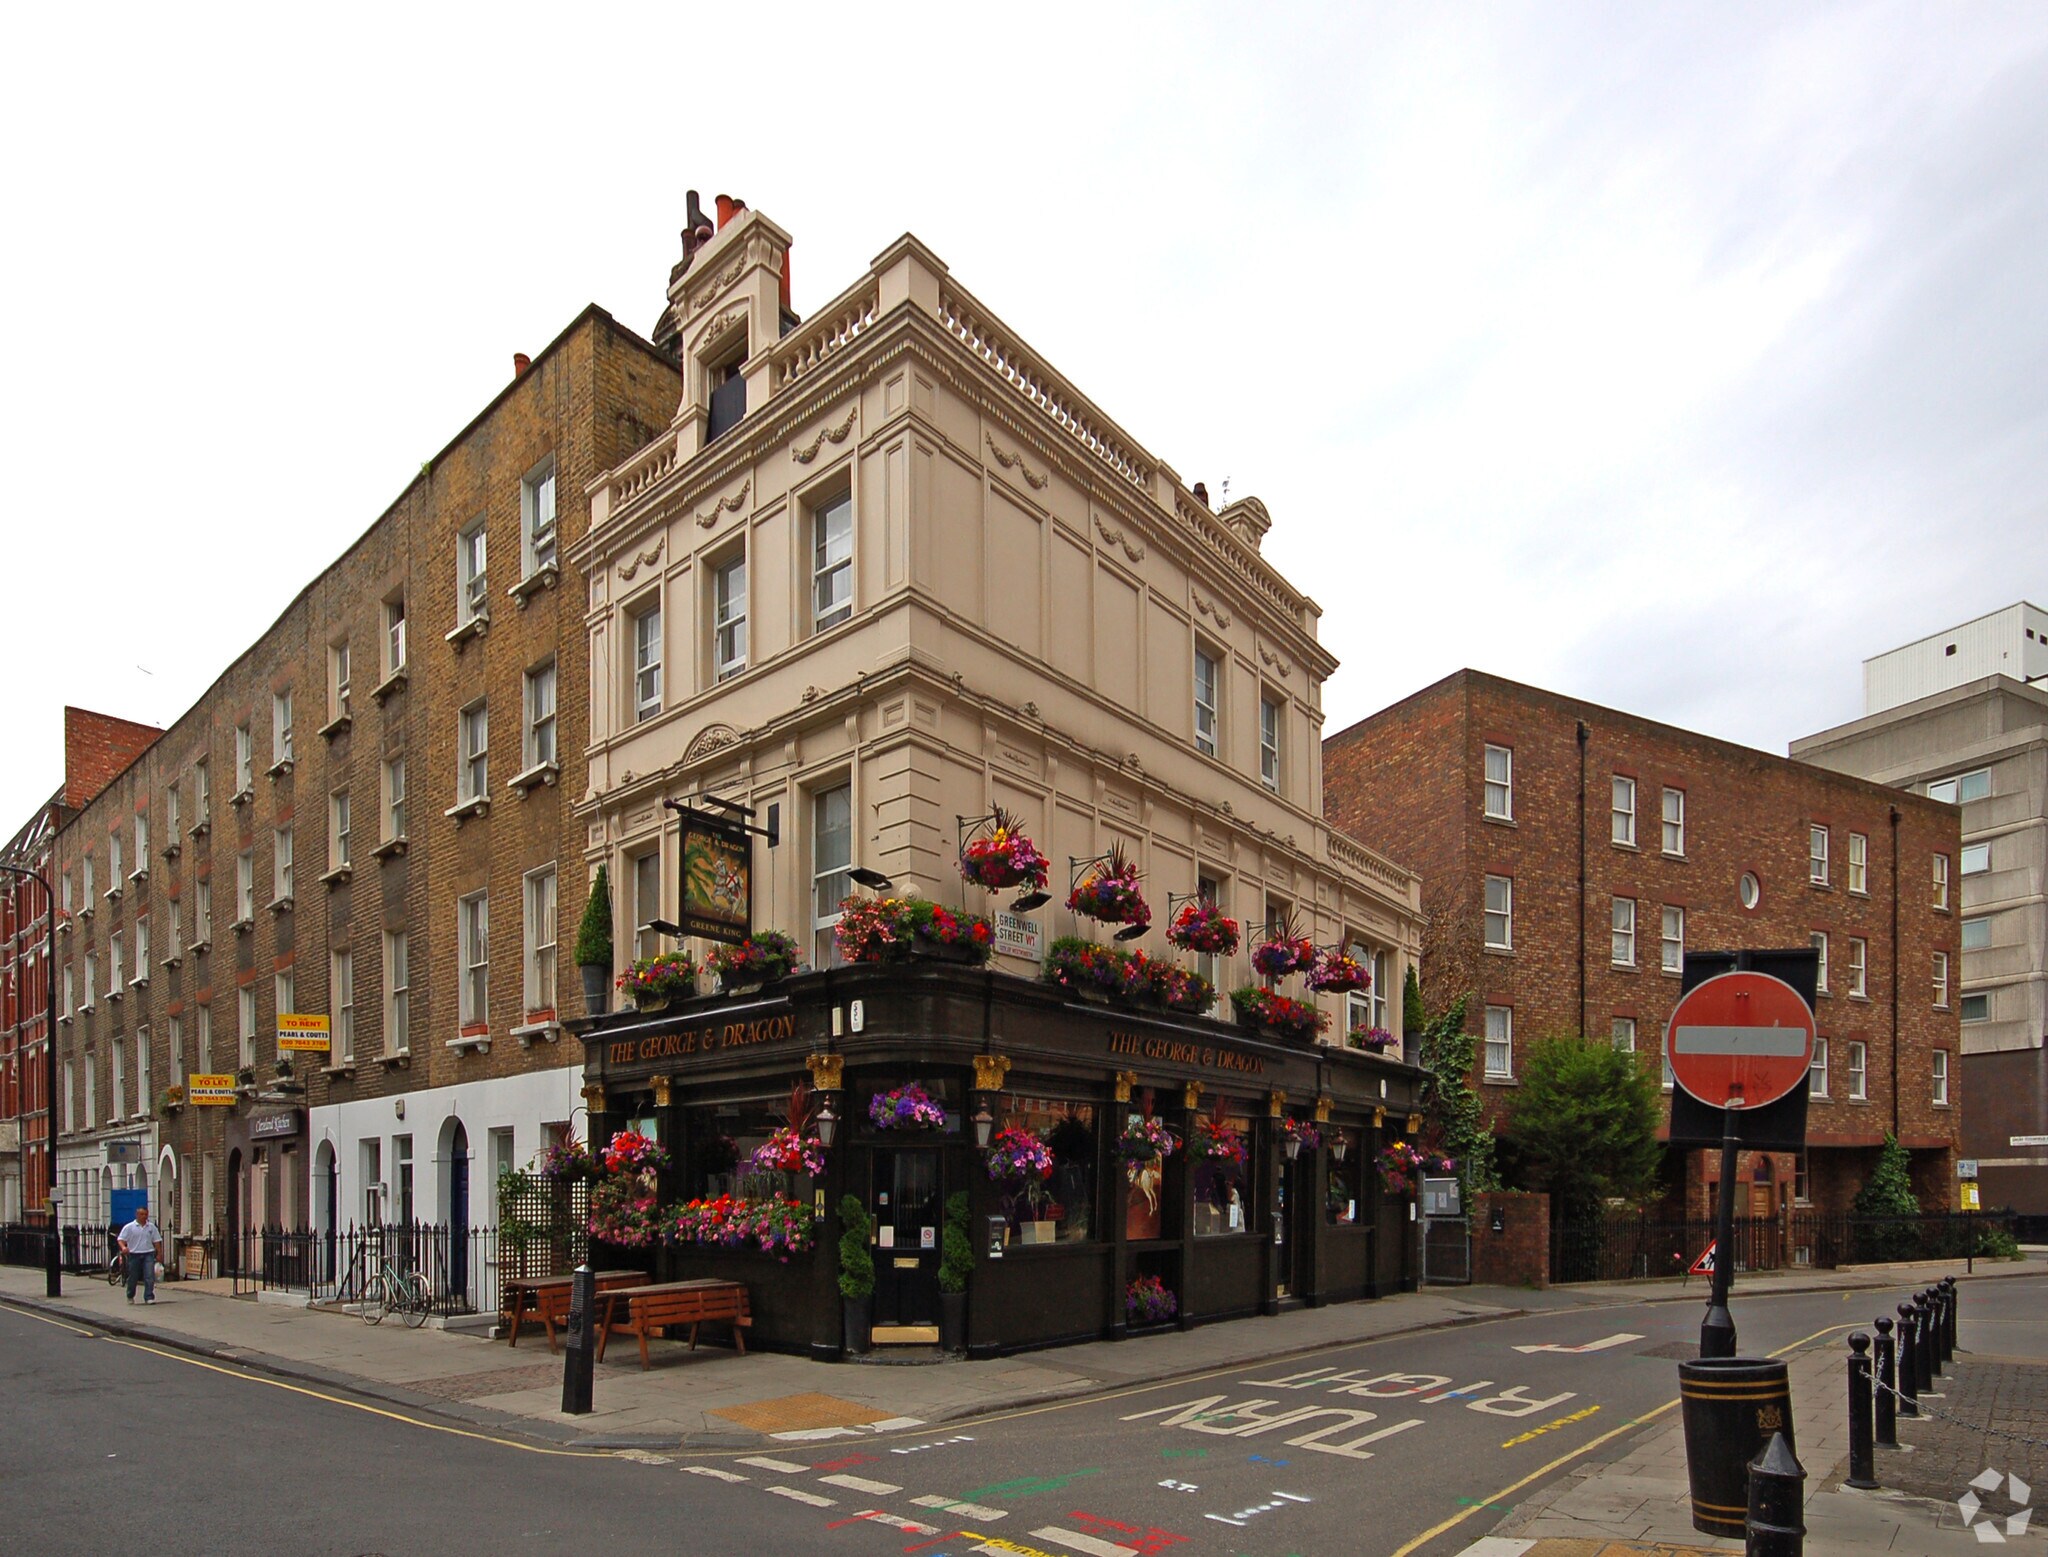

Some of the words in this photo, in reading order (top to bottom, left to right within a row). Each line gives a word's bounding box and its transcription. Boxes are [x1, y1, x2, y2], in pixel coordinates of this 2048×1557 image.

[690, 920, 721, 934] GREENE
[723, 927, 742, 938] KING
[999, 914, 1039, 935] GREENWELL
[1000, 928, 1024, 944] STREET
[1025, 934, 1036, 947] W1
[609, 1042, 635, 1064] THE
[640, 1030, 697, 1060] GEORGE
[702, 1028, 714, 1050] &
[721, 1015, 796, 1048] DRAGON
[1111, 1032, 1141, 1055] THE
[1145, 1038, 1199, 1064] GEORGE
[1202, 1047, 1213, 1066] &
[1217, 1050, 1265, 1073] DRAGON
[1238, 1367, 1578, 1418] RIGHT
[1119, 1395, 1426, 1459] TURN
